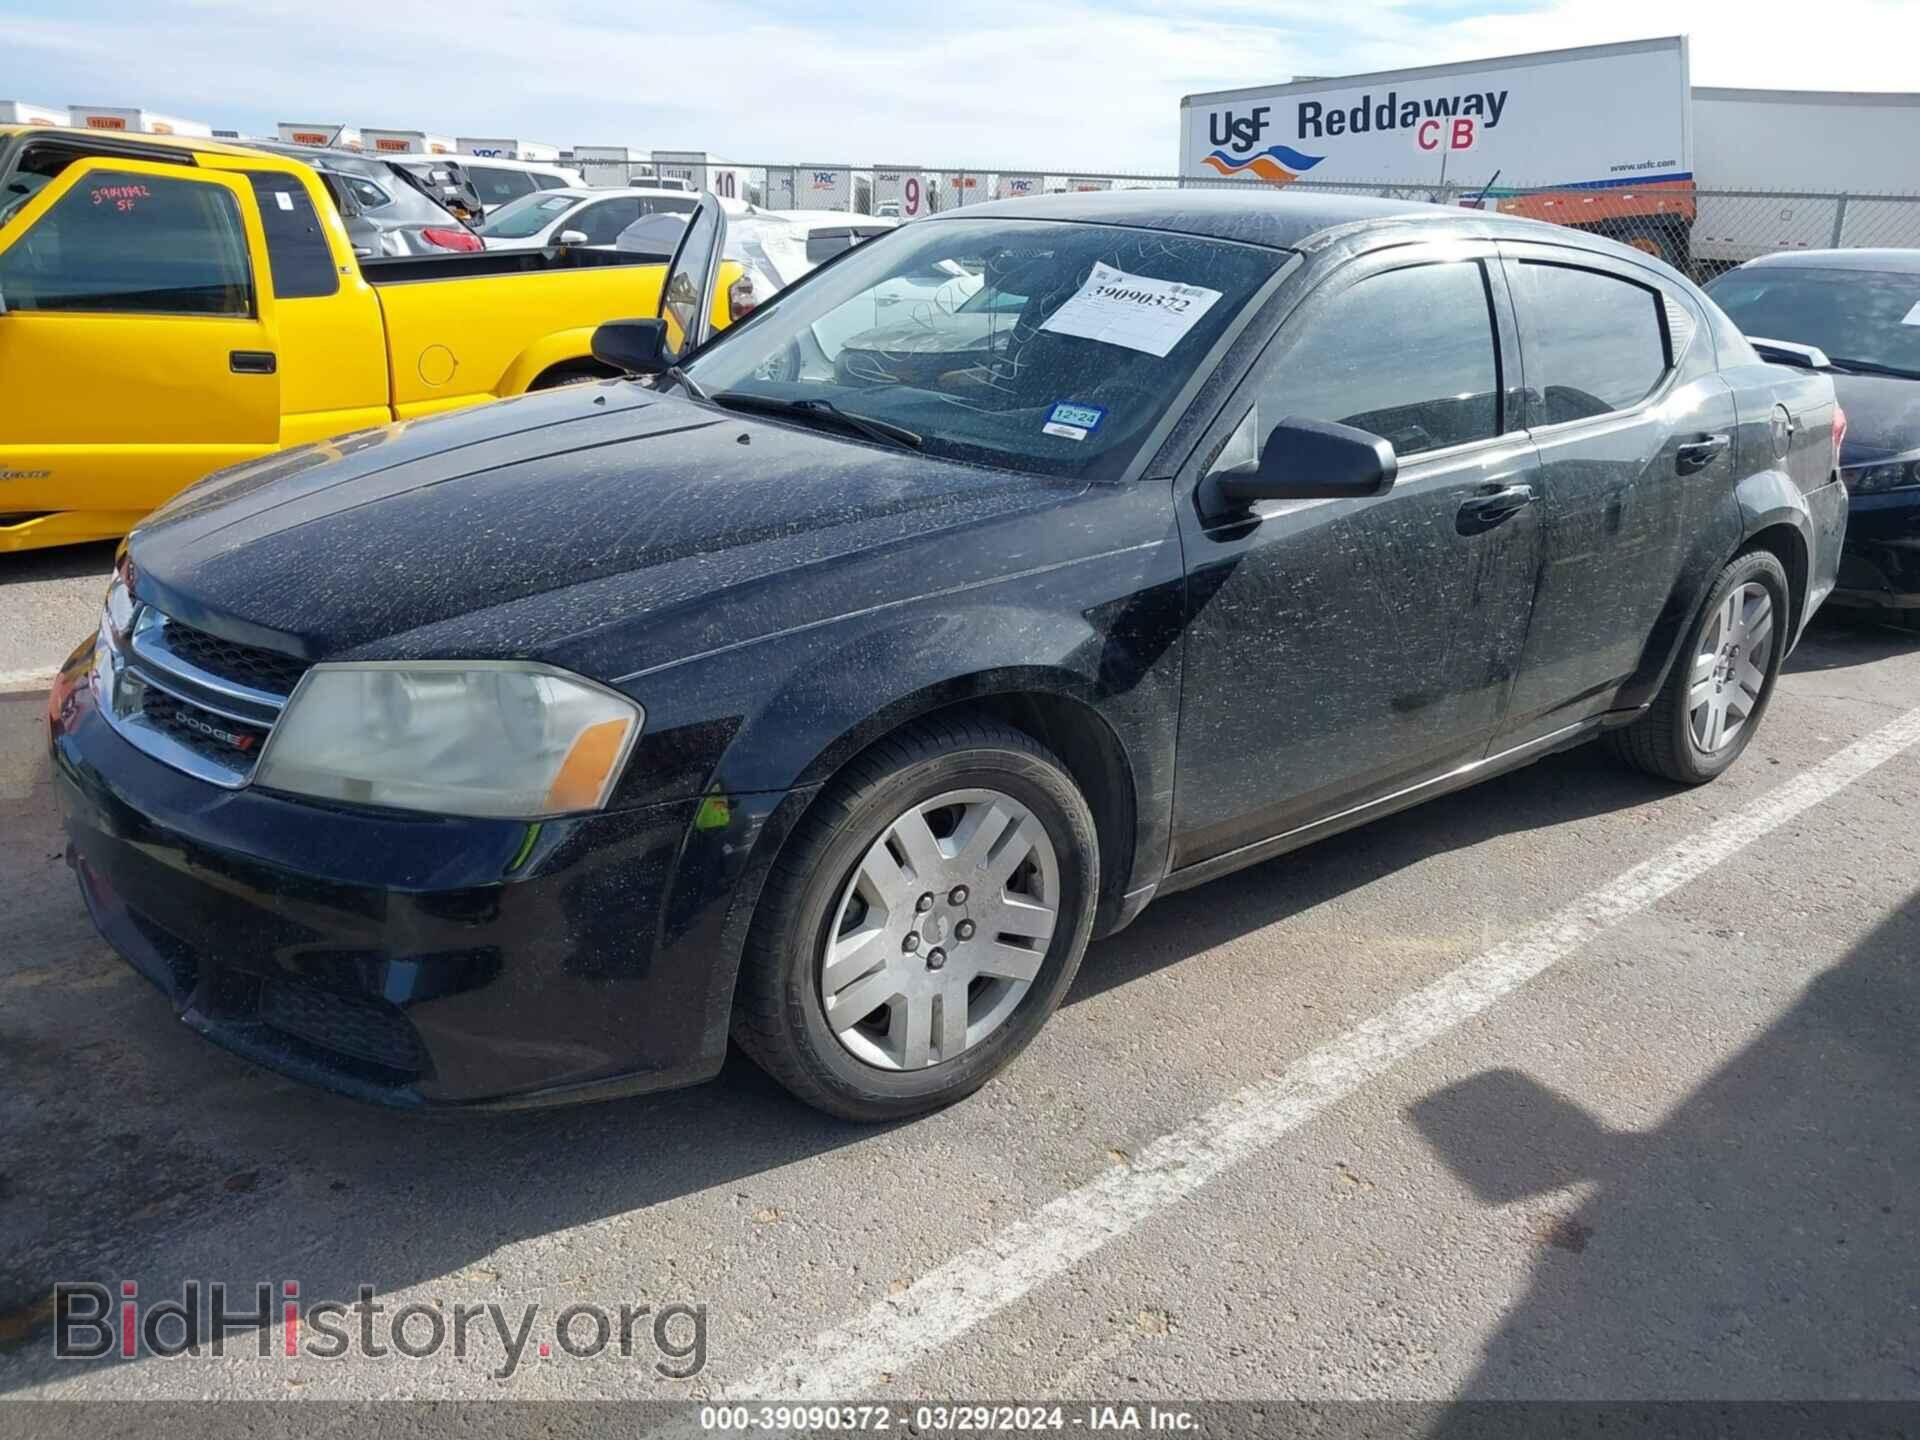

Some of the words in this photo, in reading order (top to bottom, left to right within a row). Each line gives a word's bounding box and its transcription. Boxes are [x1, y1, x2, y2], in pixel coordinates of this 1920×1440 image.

[1209, 106, 1271, 153] USF
[1298, 90, 1508, 139] Reddaway
[1418, 120, 1440, 150] C
[1450, 119, 1474, 149] B
[716, 171, 735, 199] 10
[813, 172, 838, 184] YRC
[1009, 180, 1033, 191] YRC
[904, 177, 921, 215] 9
[1088, 286, 1191, 312] 39090372
[175, 711, 241, 746] DODGE
